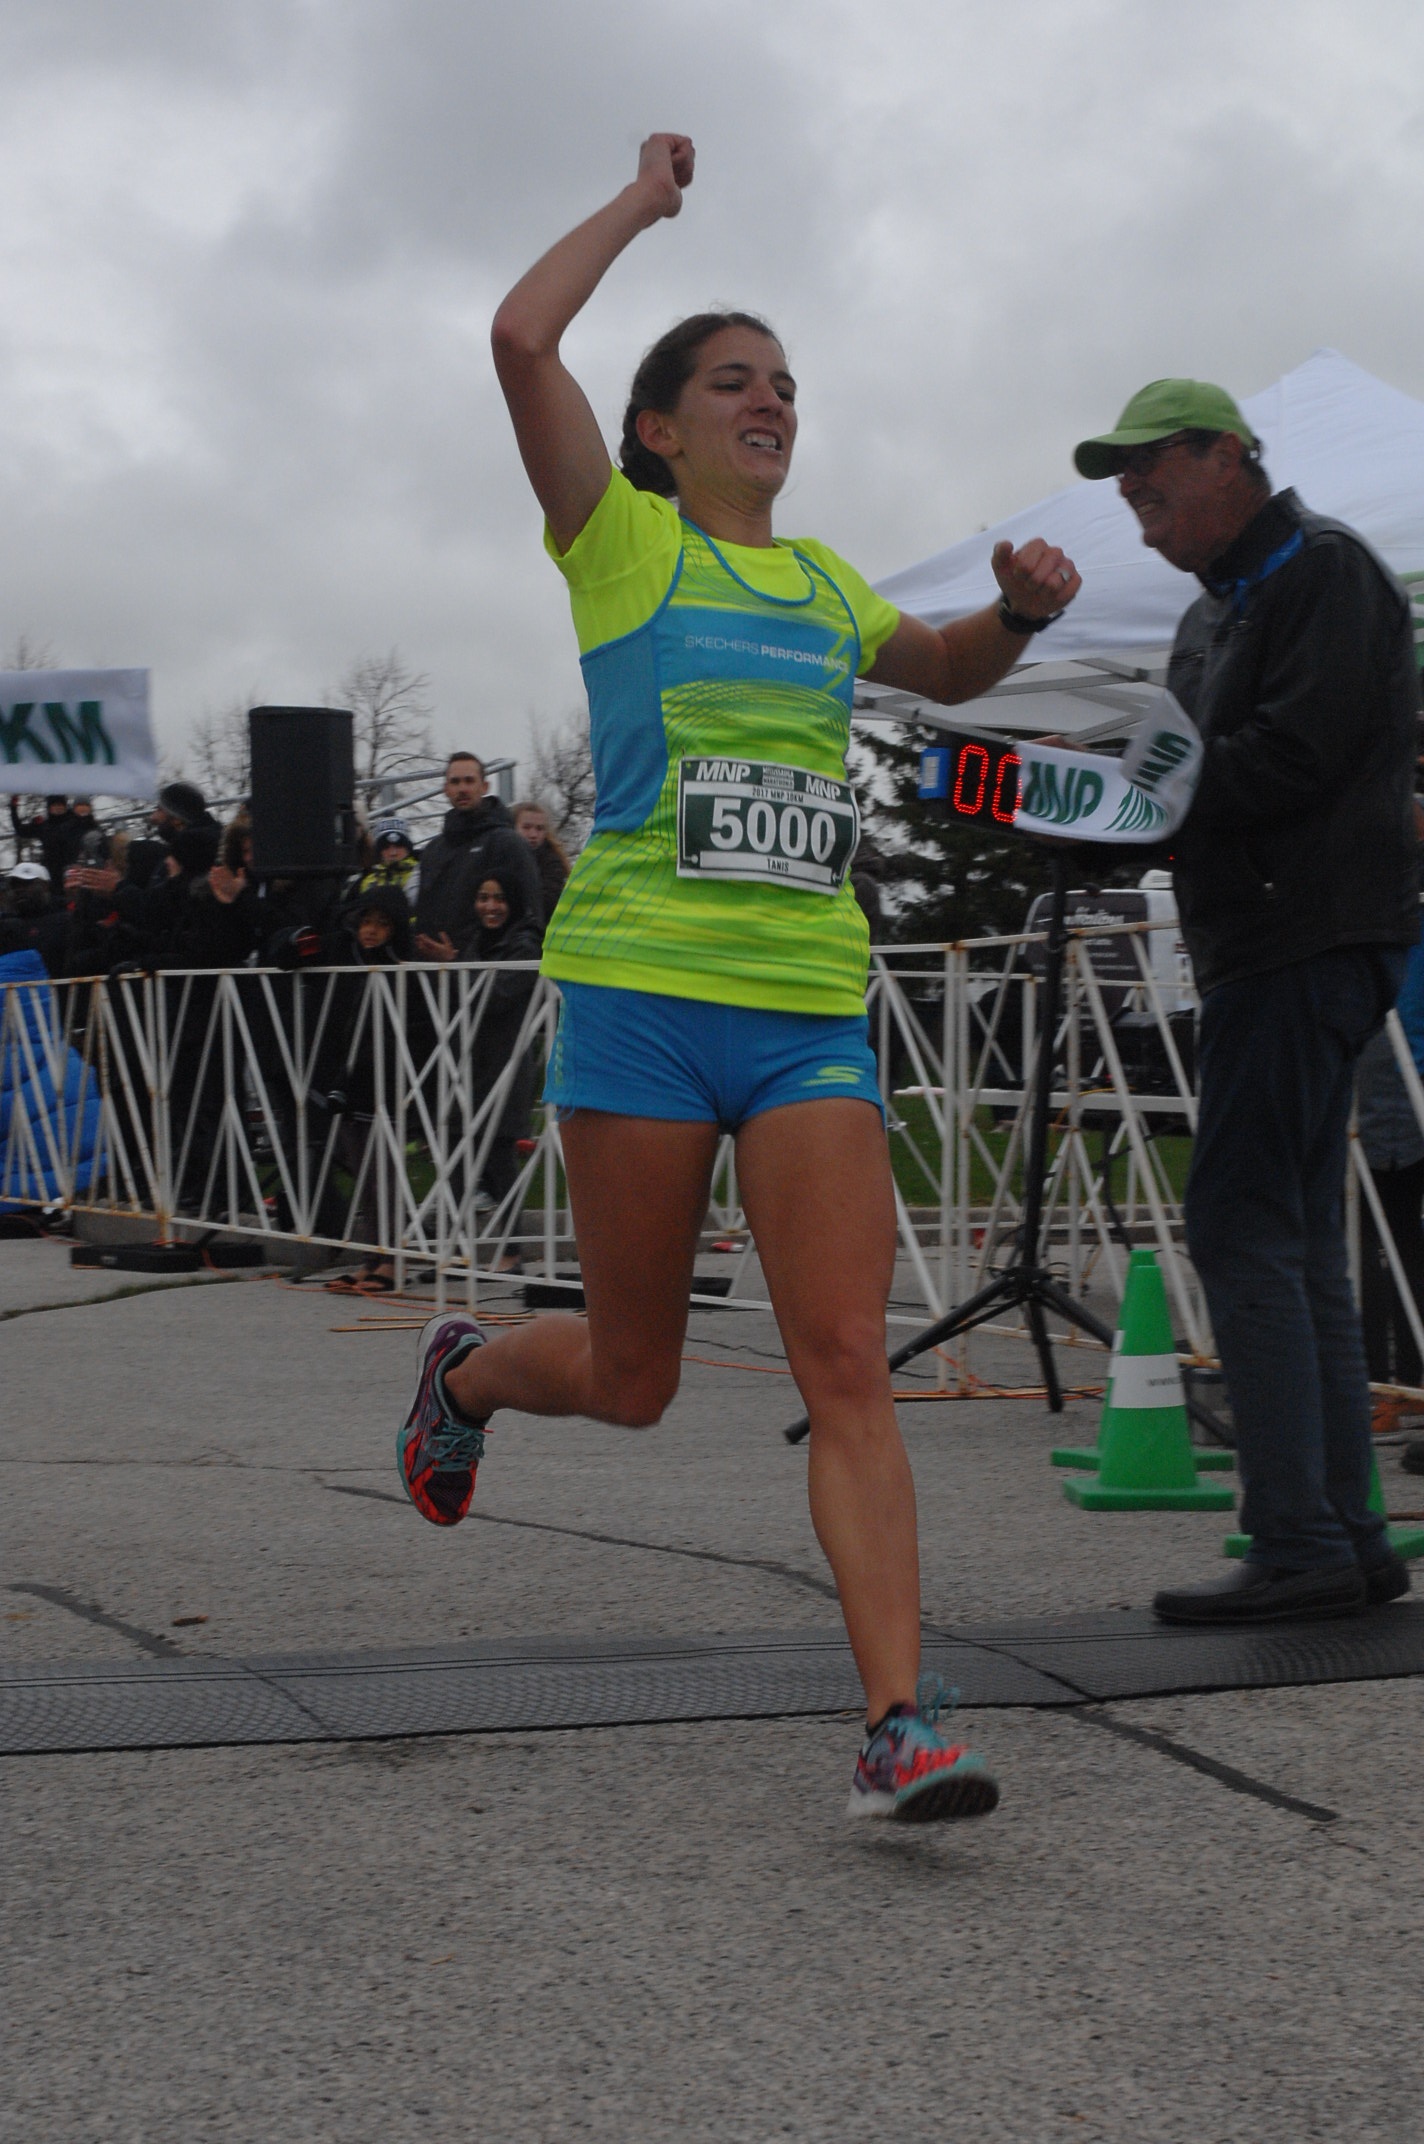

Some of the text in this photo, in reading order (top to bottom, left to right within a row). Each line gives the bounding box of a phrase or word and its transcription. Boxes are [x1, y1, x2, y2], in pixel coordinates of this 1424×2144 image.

[684, 635, 760, 655] SKECHERS
[696, 761, 751, 782] MNP
[752, 786, 804, 803] 2017 MNP 10KM
[805, 775, 841, 800] MNP
[709, 796, 836, 863] 5000
[767, 859, 789, 872] TANIS
